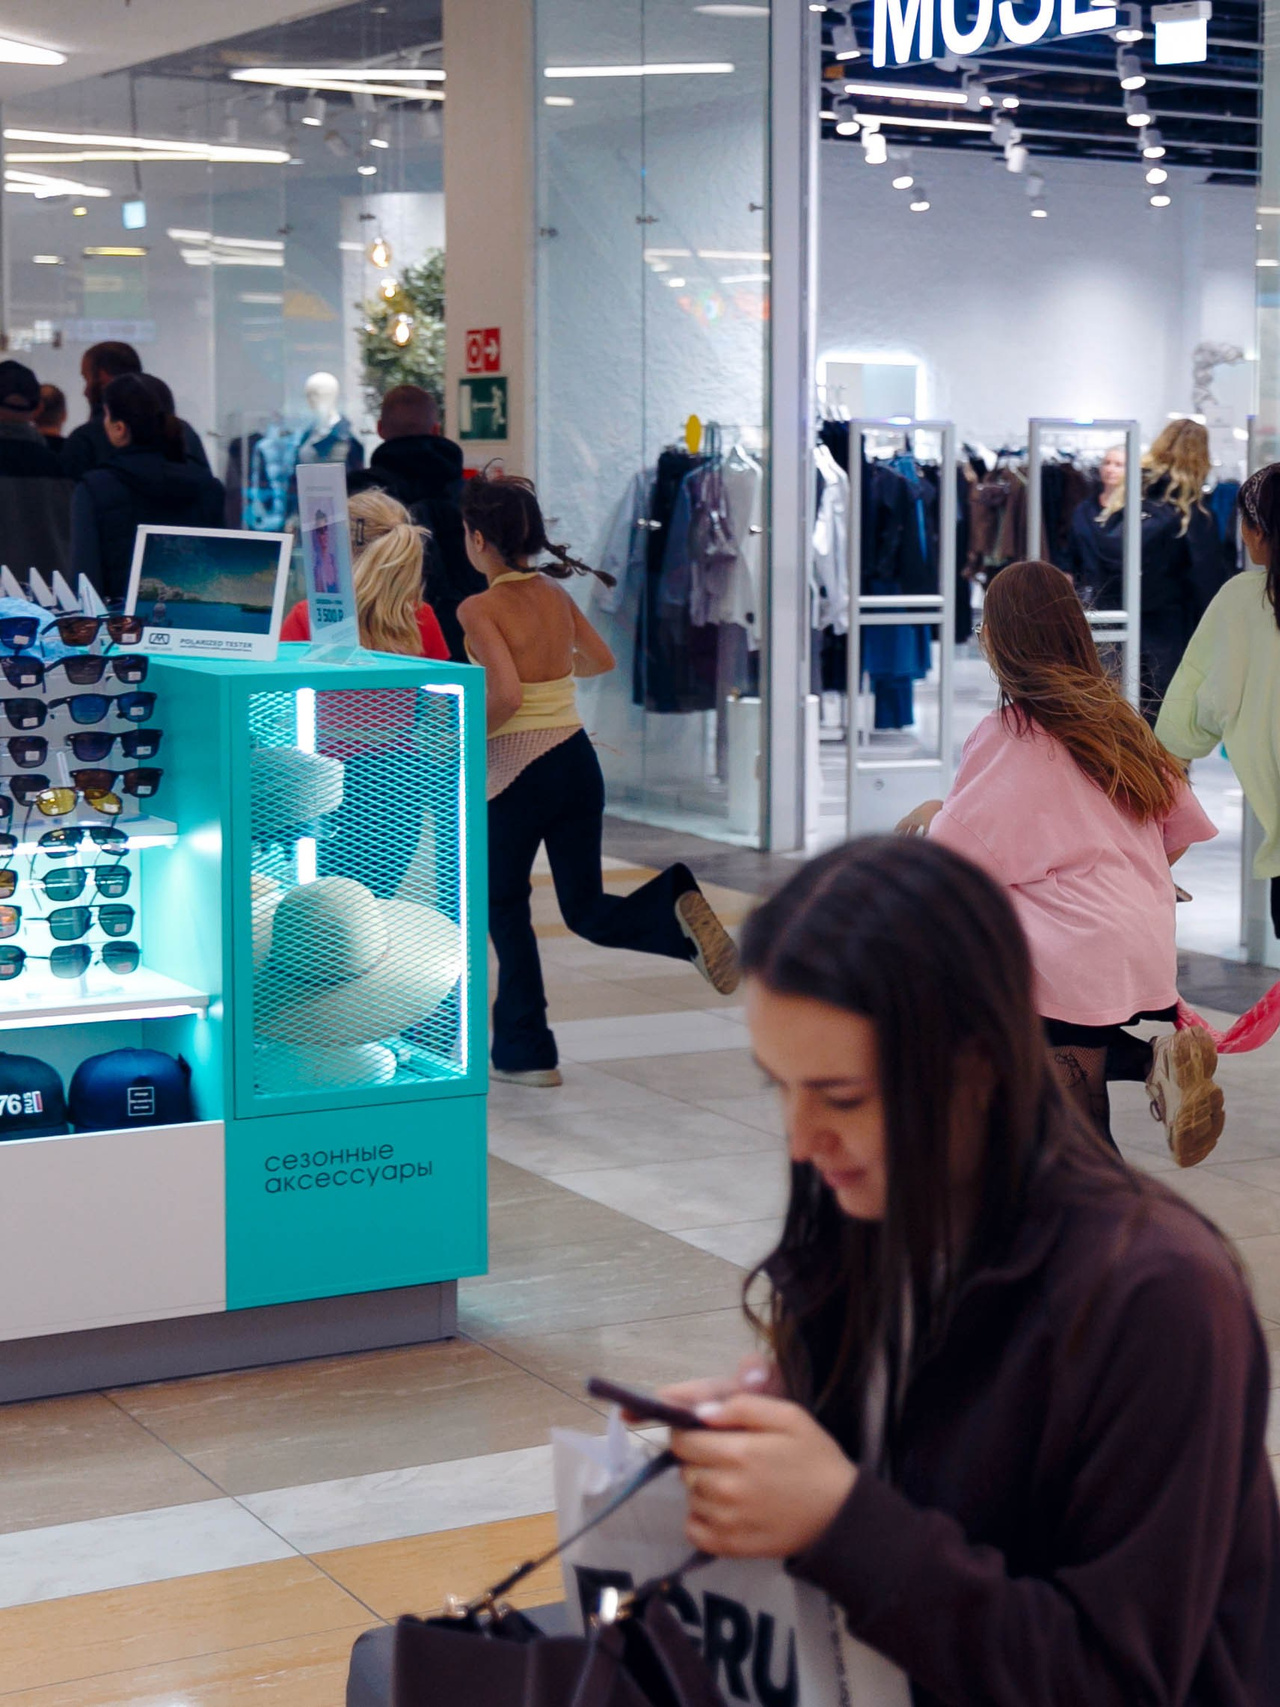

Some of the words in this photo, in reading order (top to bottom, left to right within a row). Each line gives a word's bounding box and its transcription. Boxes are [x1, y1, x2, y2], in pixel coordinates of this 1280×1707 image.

[179, 637, 224, 647] POLARIZED
[224, 640, 253, 649] TESTER
[23, 1091, 34, 1114] RUS
[264, 1143, 394, 1172] сезонные
[264, 1160, 433, 1194] аксессуары
